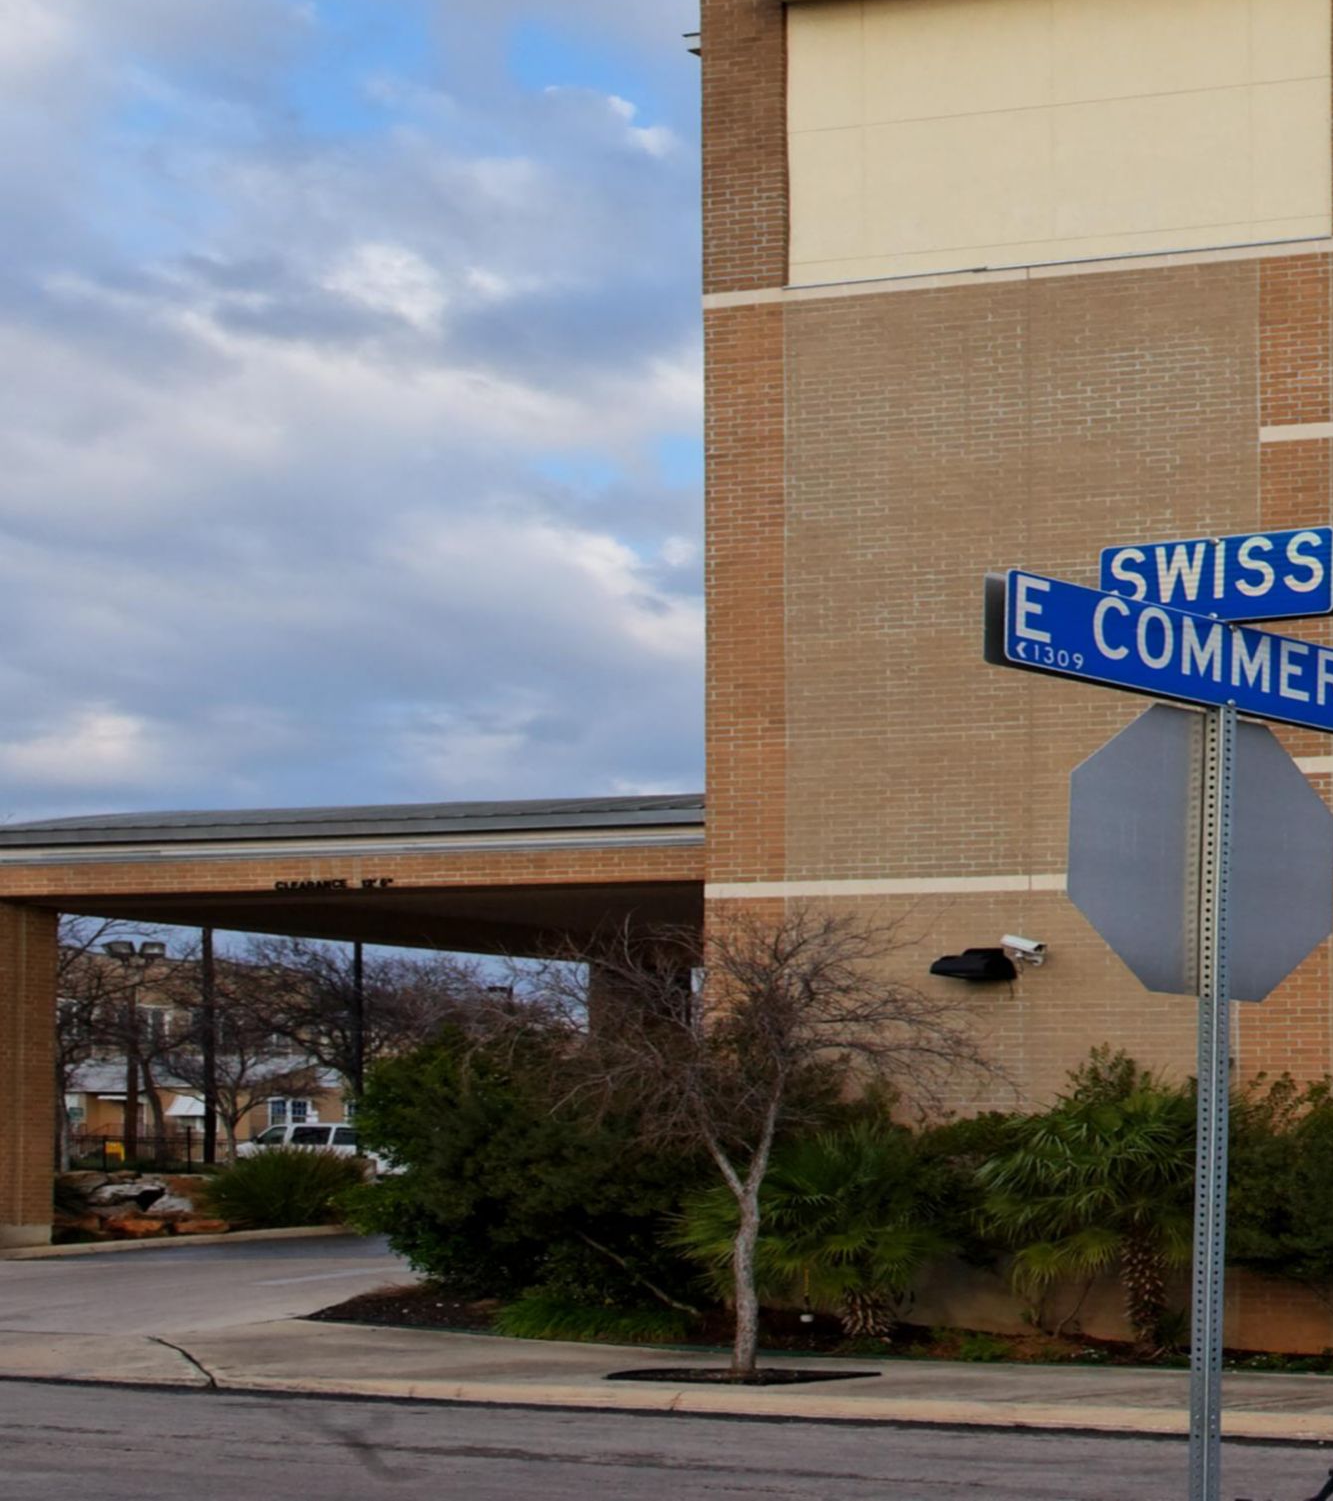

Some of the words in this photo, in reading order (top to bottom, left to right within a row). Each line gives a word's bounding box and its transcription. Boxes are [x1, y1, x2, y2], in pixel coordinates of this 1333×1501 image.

[1111, 531, 1324, 603] SWISS
[1015, 576, 1051, 643] E
[1034, 644, 1084, 669] 1309
